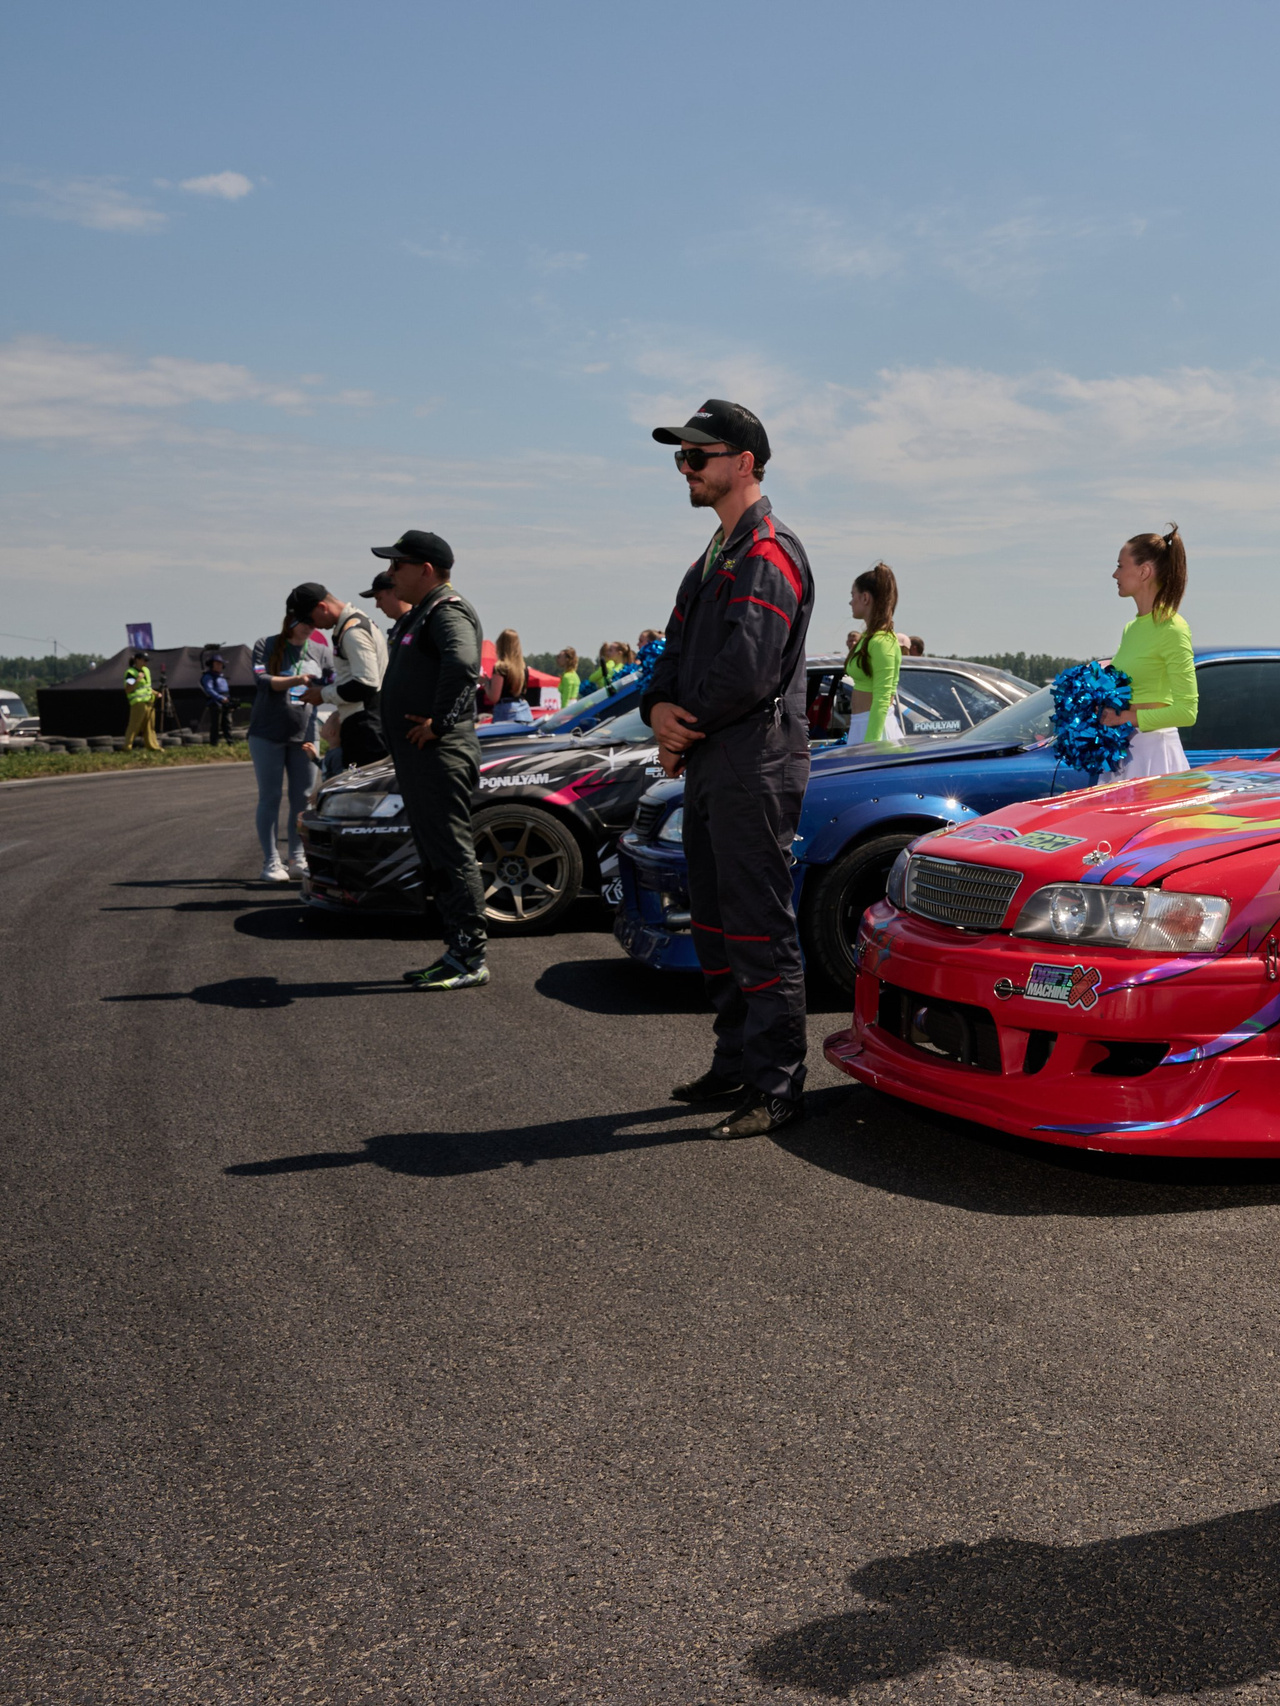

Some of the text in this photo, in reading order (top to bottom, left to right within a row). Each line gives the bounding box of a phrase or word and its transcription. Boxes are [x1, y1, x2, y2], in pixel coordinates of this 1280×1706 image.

[914, 721, 960, 730] PONULYAM
[479, 773, 549, 789] PONULYAM
[341, 826, 411, 834] POWERT
[1026, 982, 1072, 1000] MACHINE
